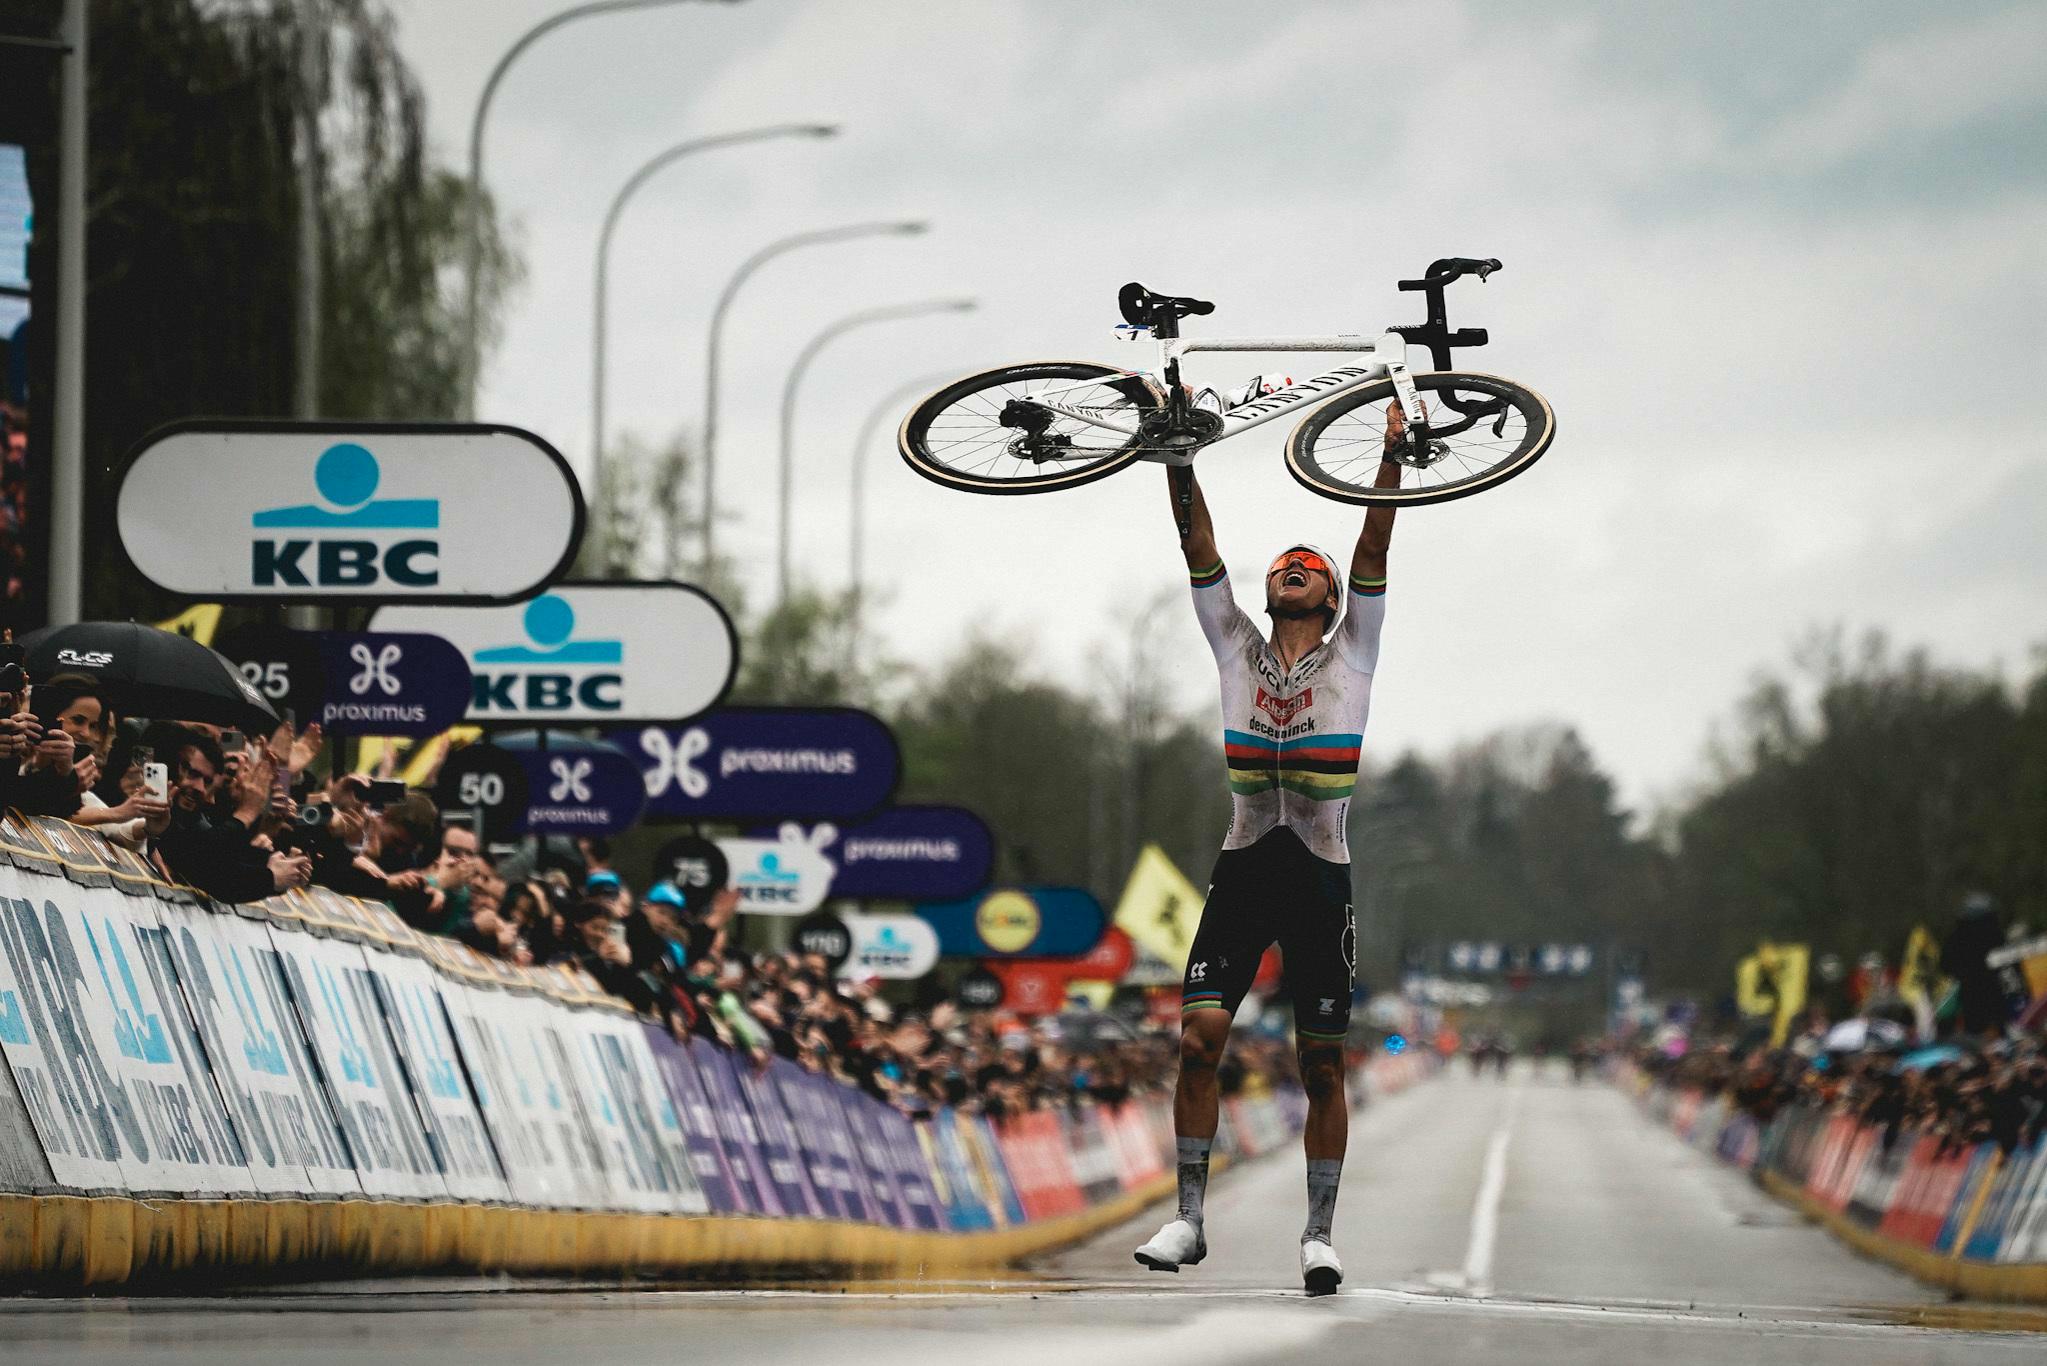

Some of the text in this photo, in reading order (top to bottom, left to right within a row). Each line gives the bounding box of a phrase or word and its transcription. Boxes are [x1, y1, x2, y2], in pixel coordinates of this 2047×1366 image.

[1225, 367, 1367, 420] CANYON
[1047, 400, 1104, 421] CANYON
[251, 540, 440, 586] KBC
[240, 661, 291, 699] 25
[473, 673, 623, 711] KBC
[323, 701, 427, 725] proximus
[720, 748, 857, 778] proximus
[458, 772, 505, 805] 50
[527, 805, 611, 827] proximus
